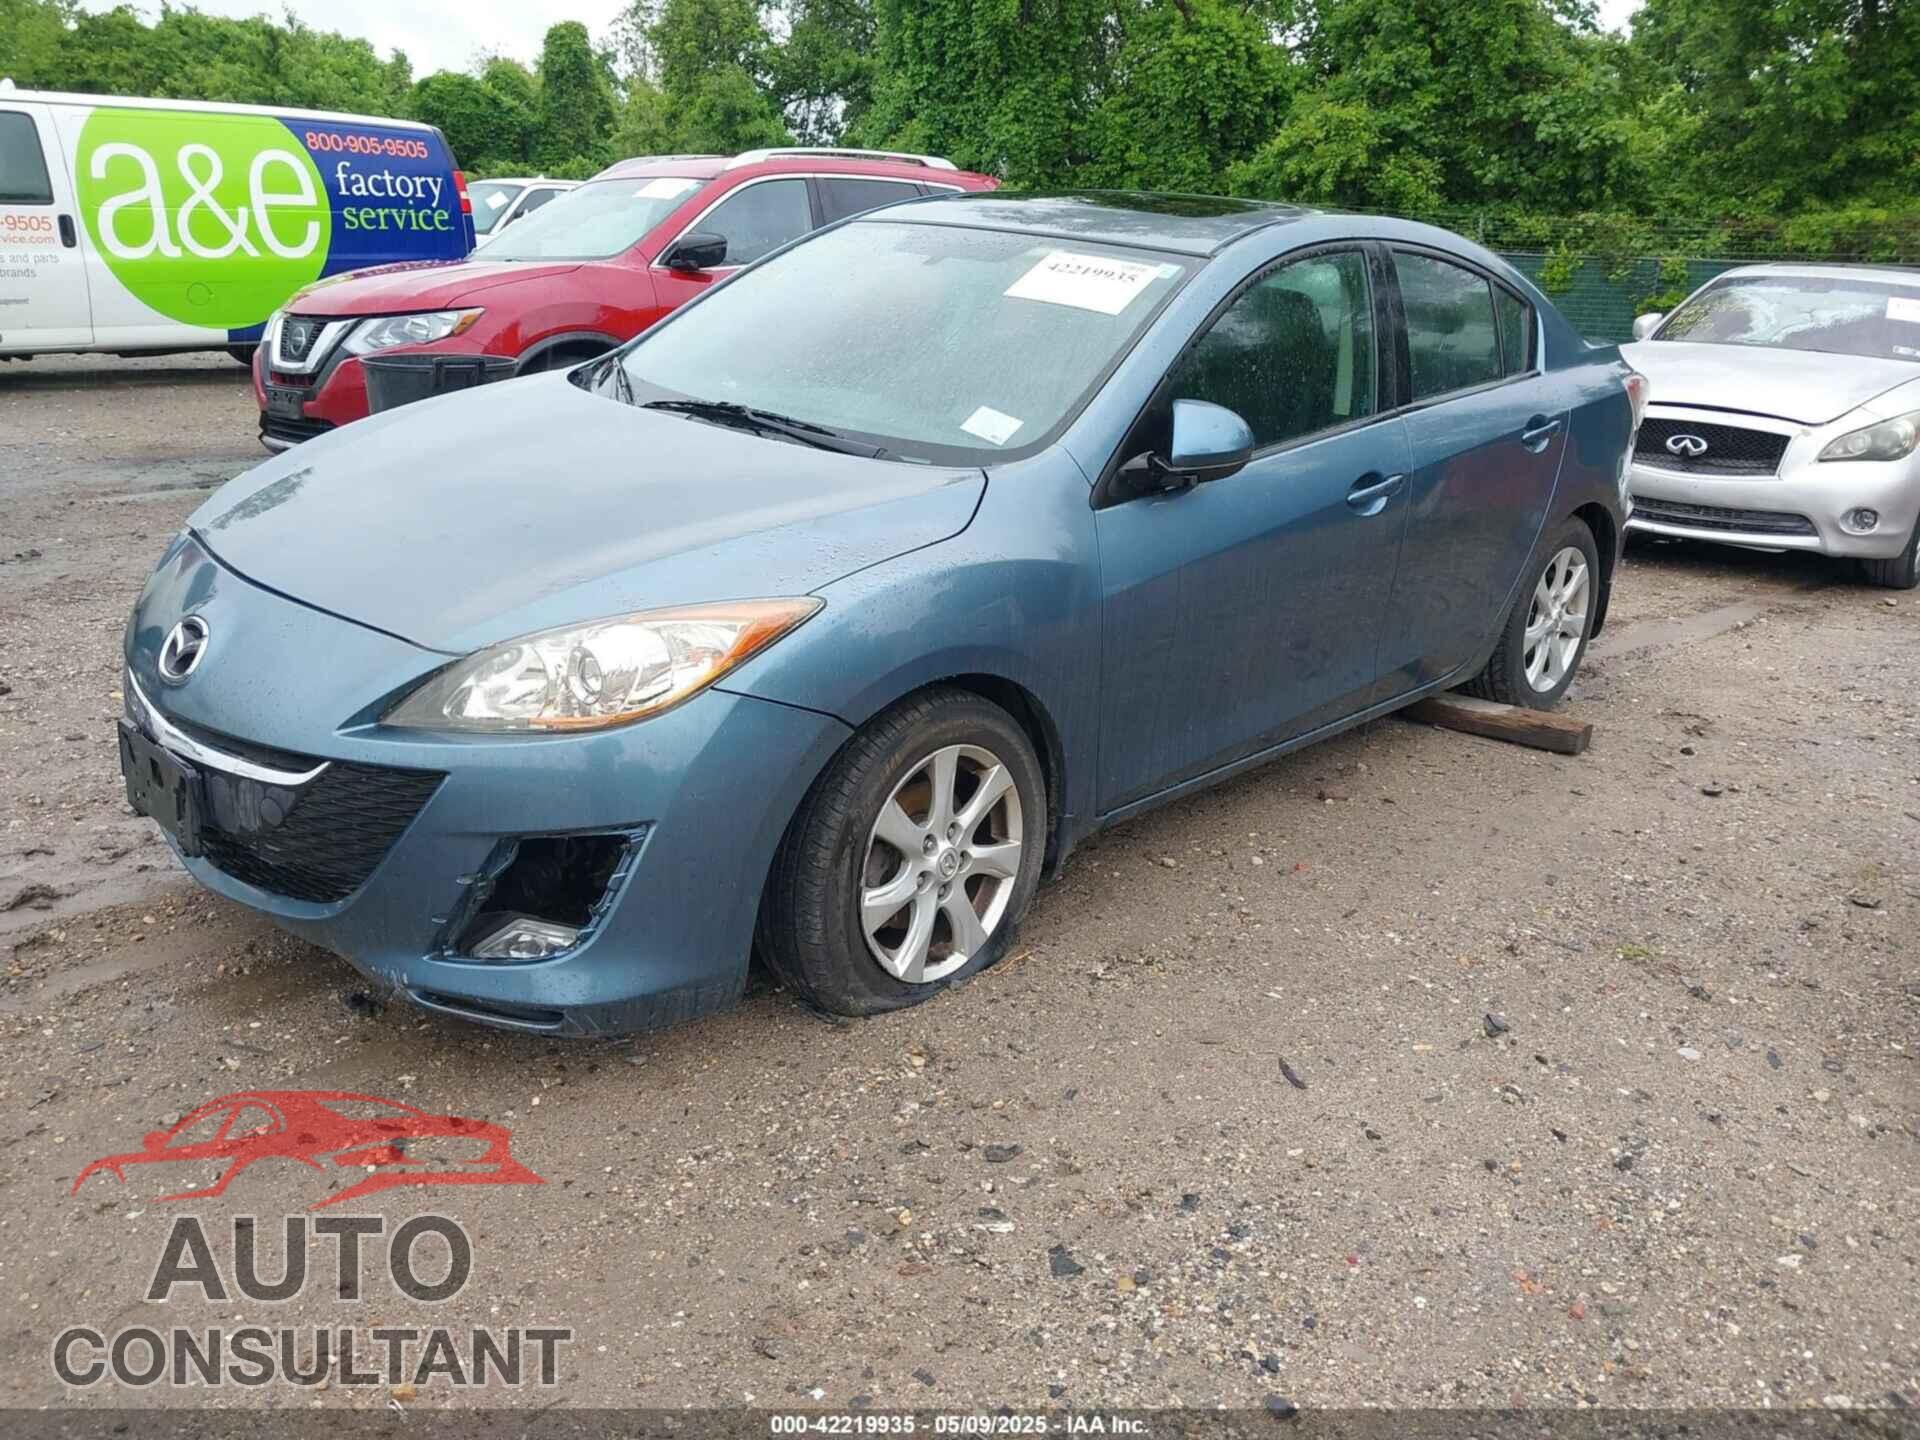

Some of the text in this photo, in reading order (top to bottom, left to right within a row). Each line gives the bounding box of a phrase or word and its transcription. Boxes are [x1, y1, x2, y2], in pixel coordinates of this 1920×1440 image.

[91, 143, 320, 259] a&e
[336, 161, 443, 208] factory
[343, 200, 449, 230] service
